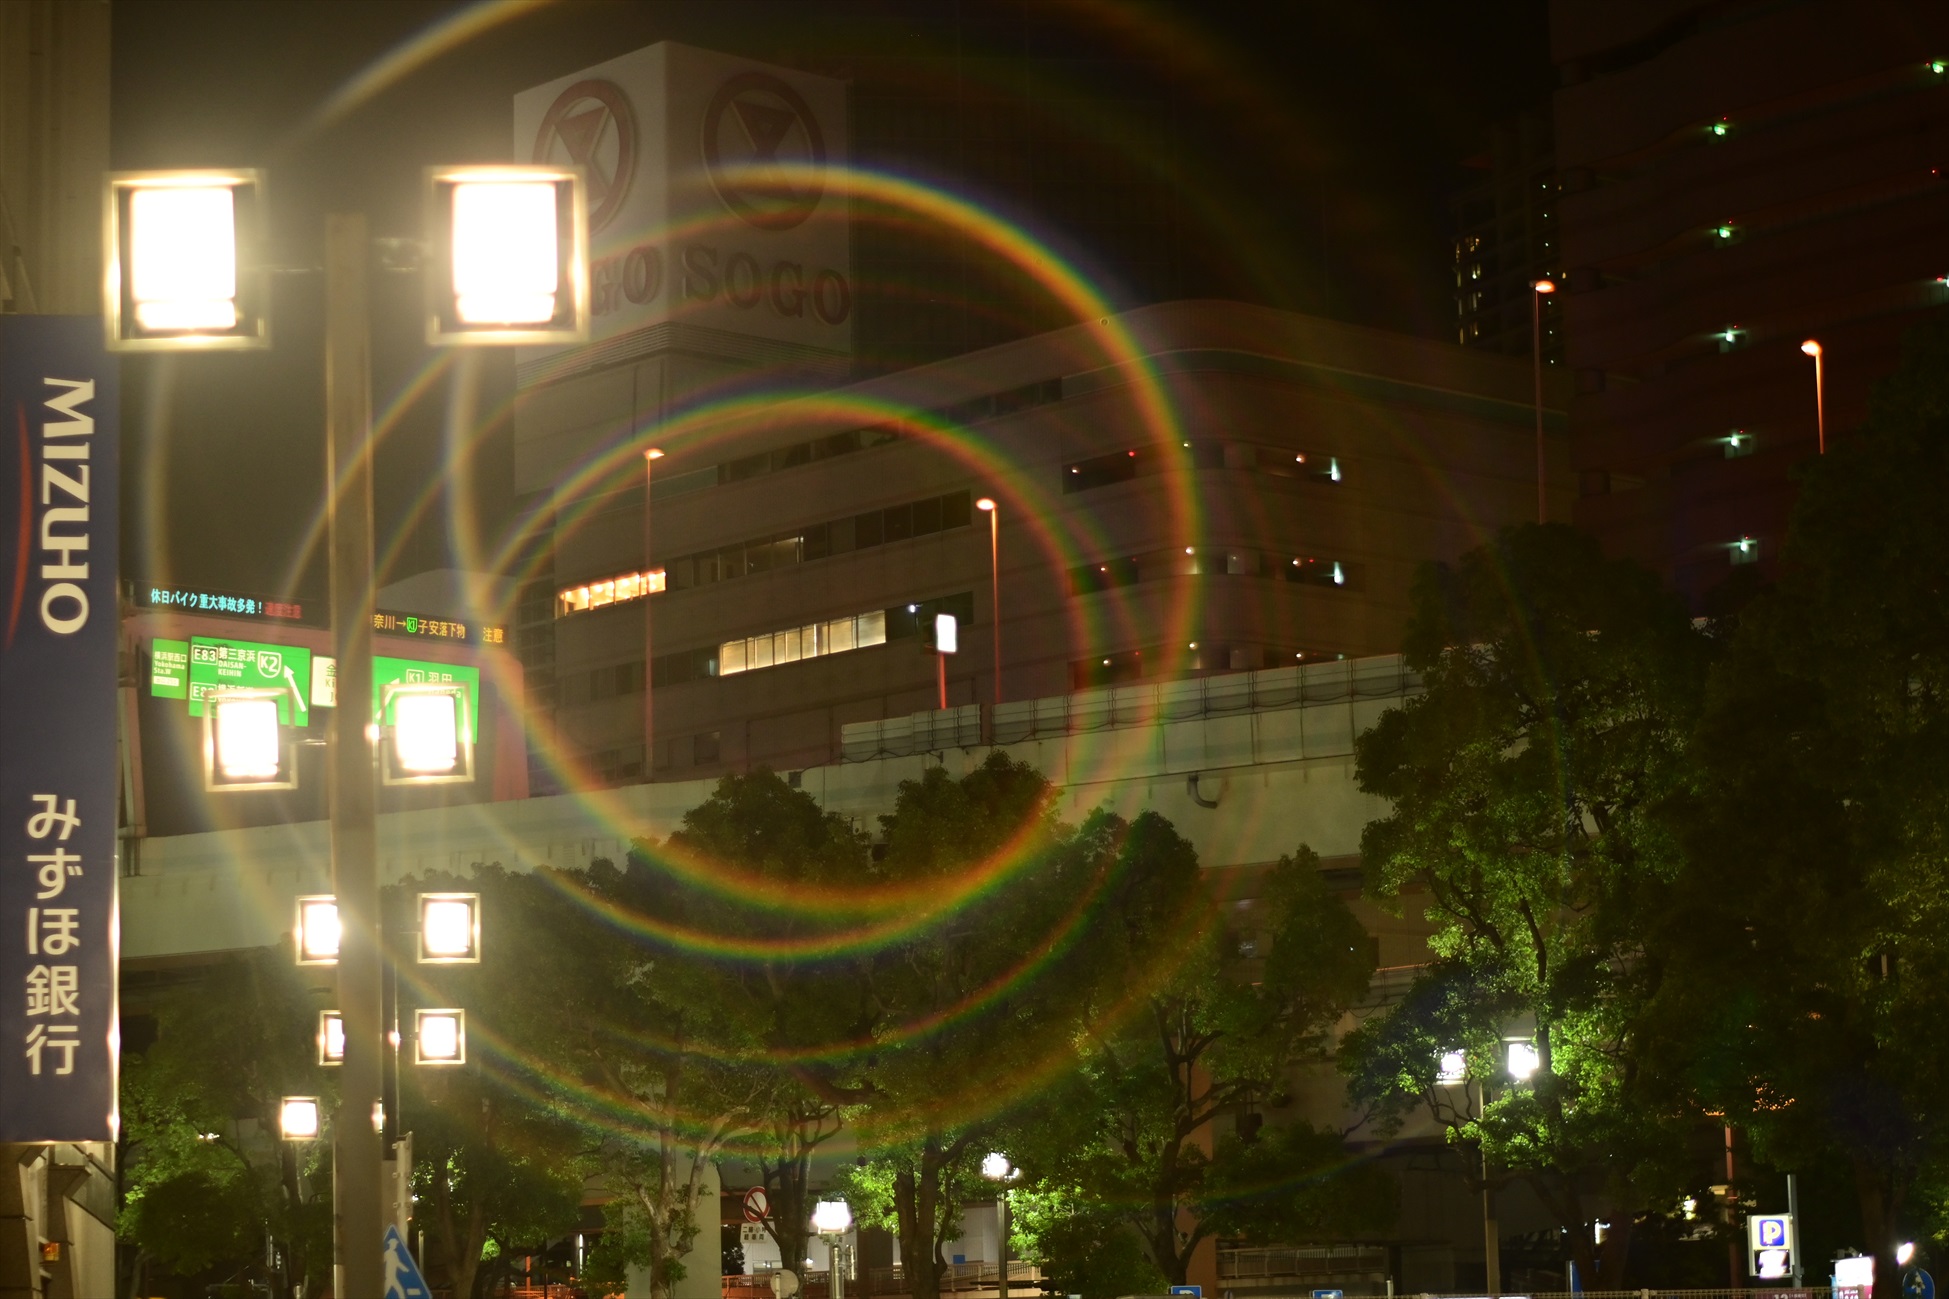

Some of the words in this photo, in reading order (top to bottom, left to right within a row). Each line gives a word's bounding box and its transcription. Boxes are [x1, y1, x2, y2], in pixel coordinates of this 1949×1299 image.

[682, 244, 850, 326] SOGO
[40, 378, 95, 635] MIZUHO
[418, 620, 465, 639] 子安落下物
[483, 627, 503, 643] 注意
[154, 661, 185, 670] Yokohama
[194, 649, 216, 662] E83
[219, 647, 256, 663] 第三京浜
[260, 656, 278, 672] K2
[218, 669, 242, 677] KEIHIN
[25, 793, 83, 1077] みずほ銀行
[1763, 1221, 1781, 1245] P
